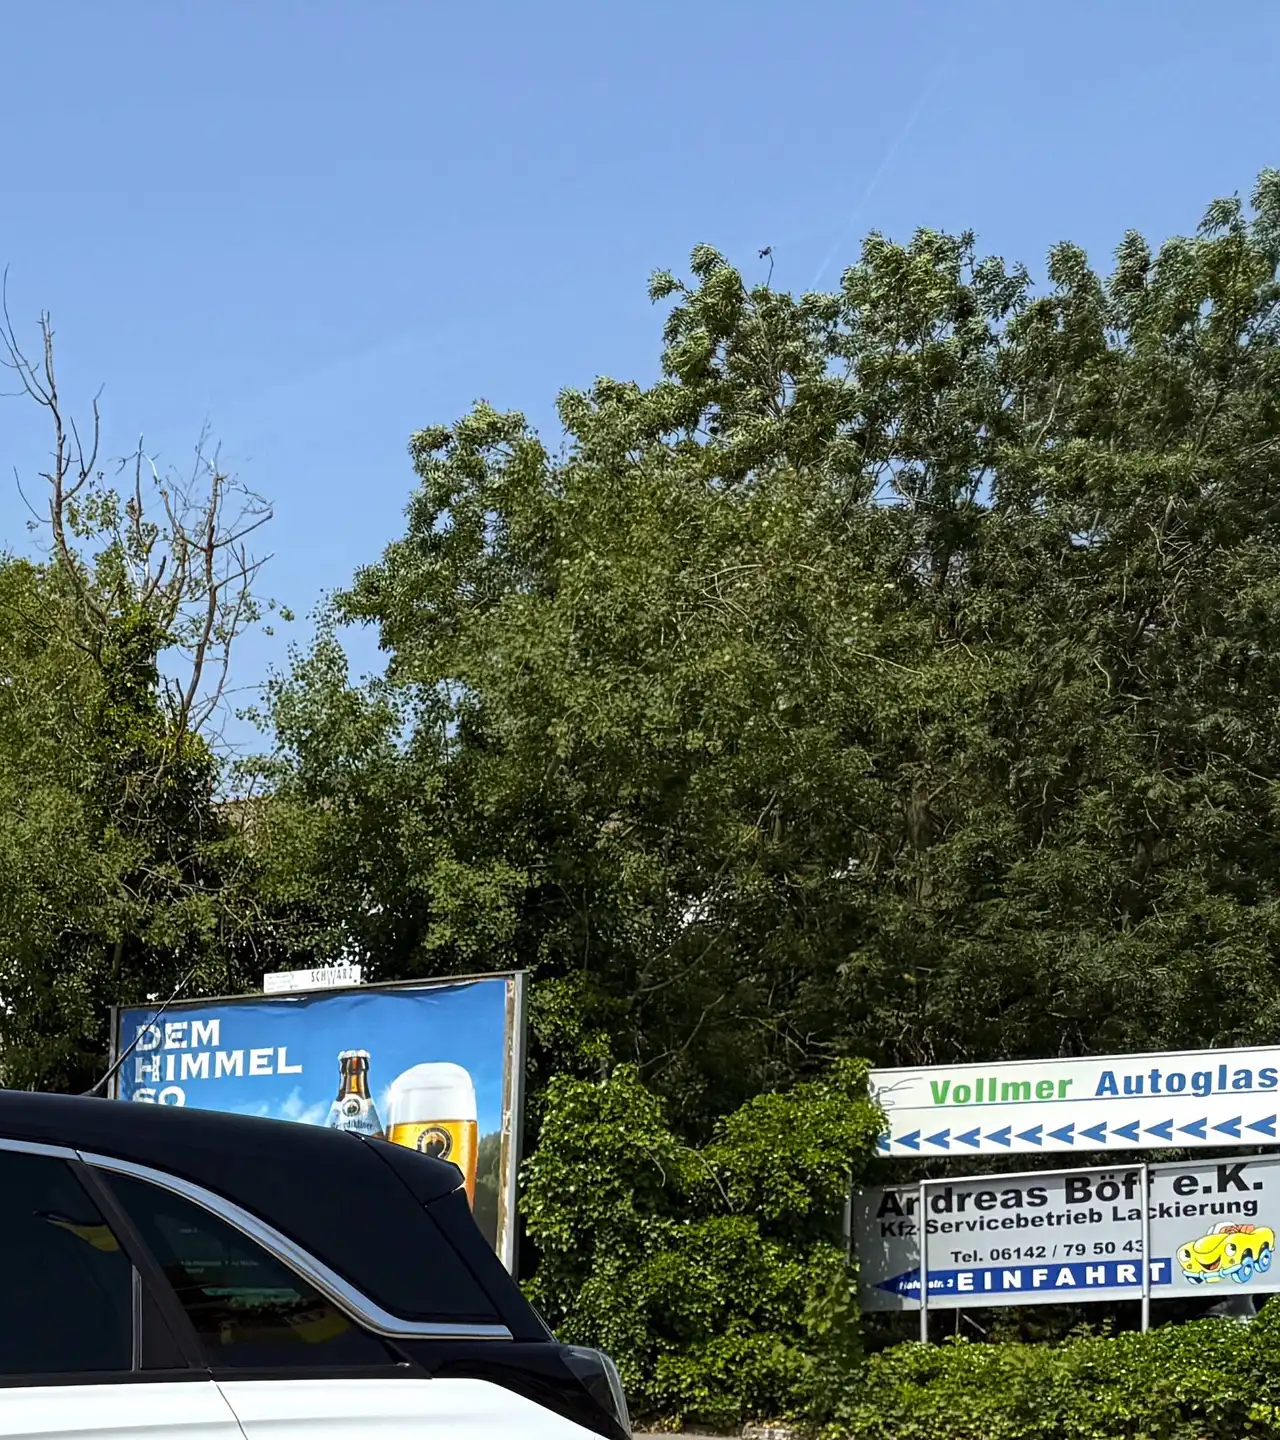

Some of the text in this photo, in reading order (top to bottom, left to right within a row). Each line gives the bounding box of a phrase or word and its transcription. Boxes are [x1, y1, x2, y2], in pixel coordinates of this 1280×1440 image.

[136, 1019, 220, 1052] DEM
[134, 1046, 303, 1083] HIMMEL
[930, 1064, 1279, 1105] Vollmer Autoglas
[1173, 1163, 1263, 1196] e.K.
[1112, 1199, 1259, 1223] Lackierung
[951, 1250, 984, 1263] Tel.
[990, 1246, 1046, 1261] 06142
[1063, 1243, 1086, 1257] 79
[1093, 1241, 1116, 1255] 50
[957, 1262, 1166, 1292] EINFAHRT
